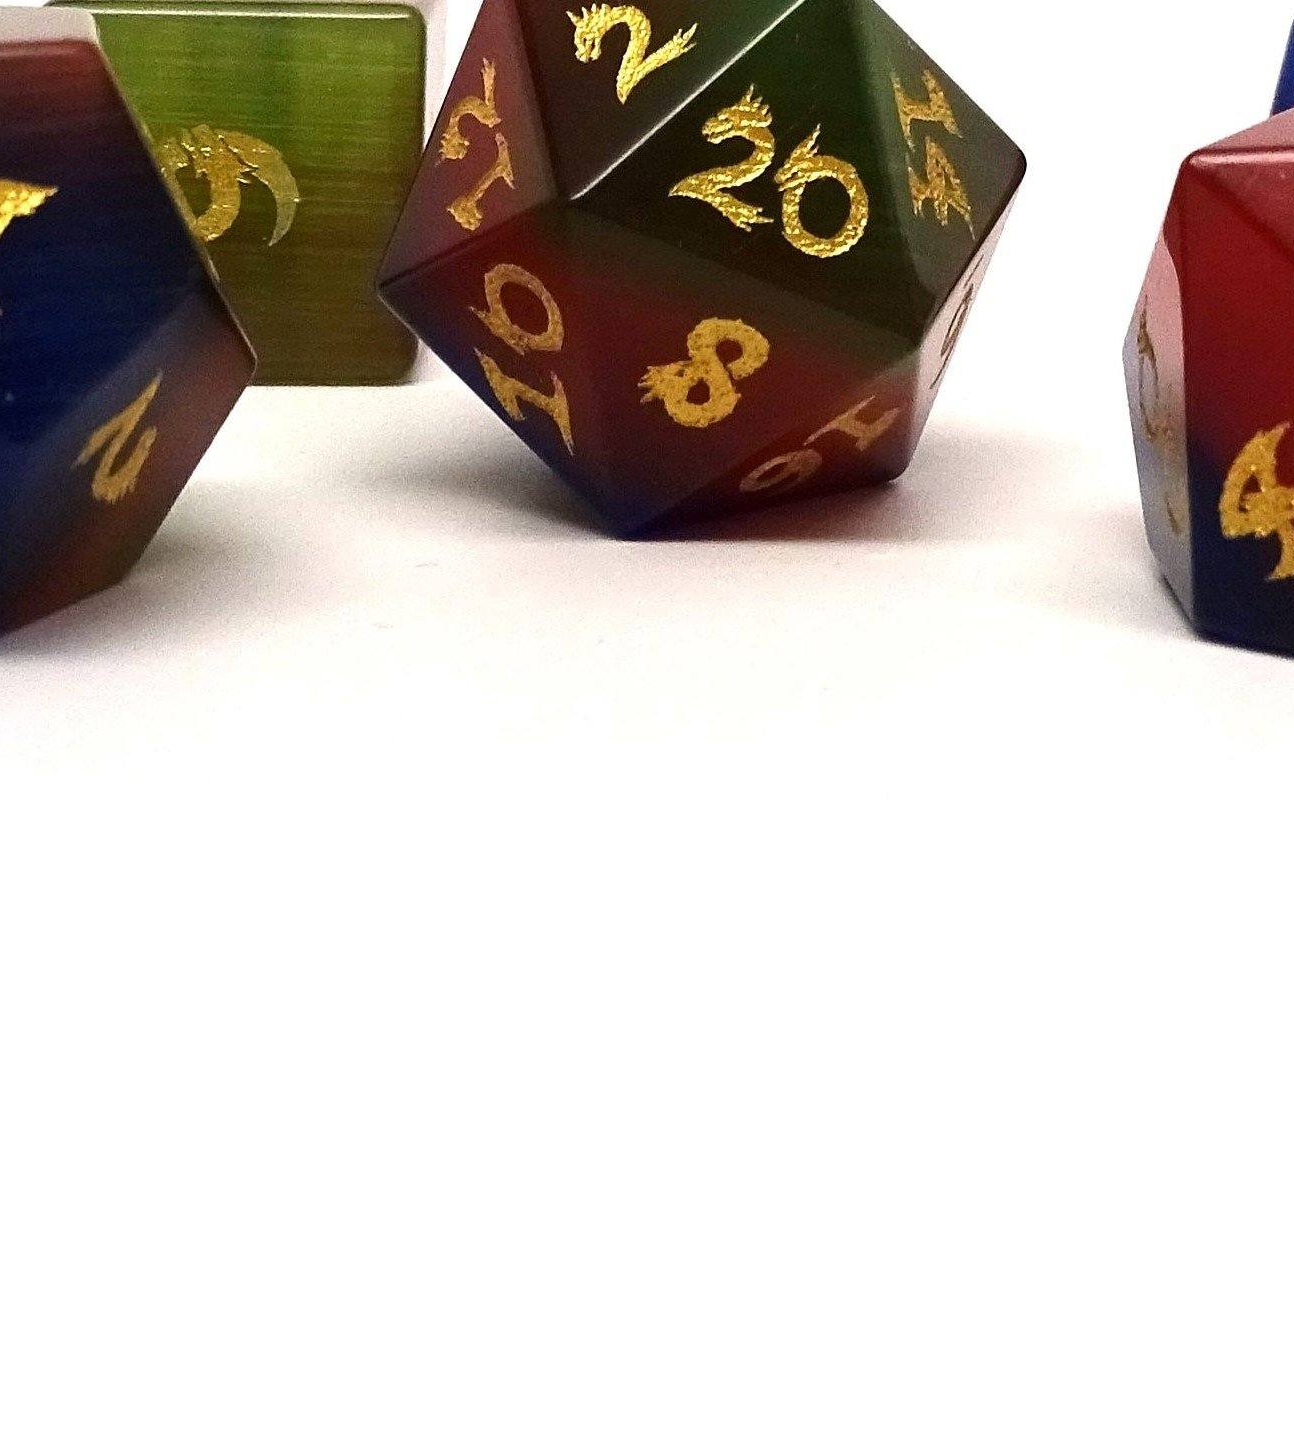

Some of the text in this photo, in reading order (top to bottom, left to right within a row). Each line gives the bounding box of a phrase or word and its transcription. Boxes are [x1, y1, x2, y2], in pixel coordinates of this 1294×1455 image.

[566, 1, 699, 104] 2
[437, 55, 515, 232] 12
[667, 83, 870, 258] 20
[888, 56, 976, 241] 14
[469, 262, 574, 457] 10
[638, 317, 771, 429] 8
